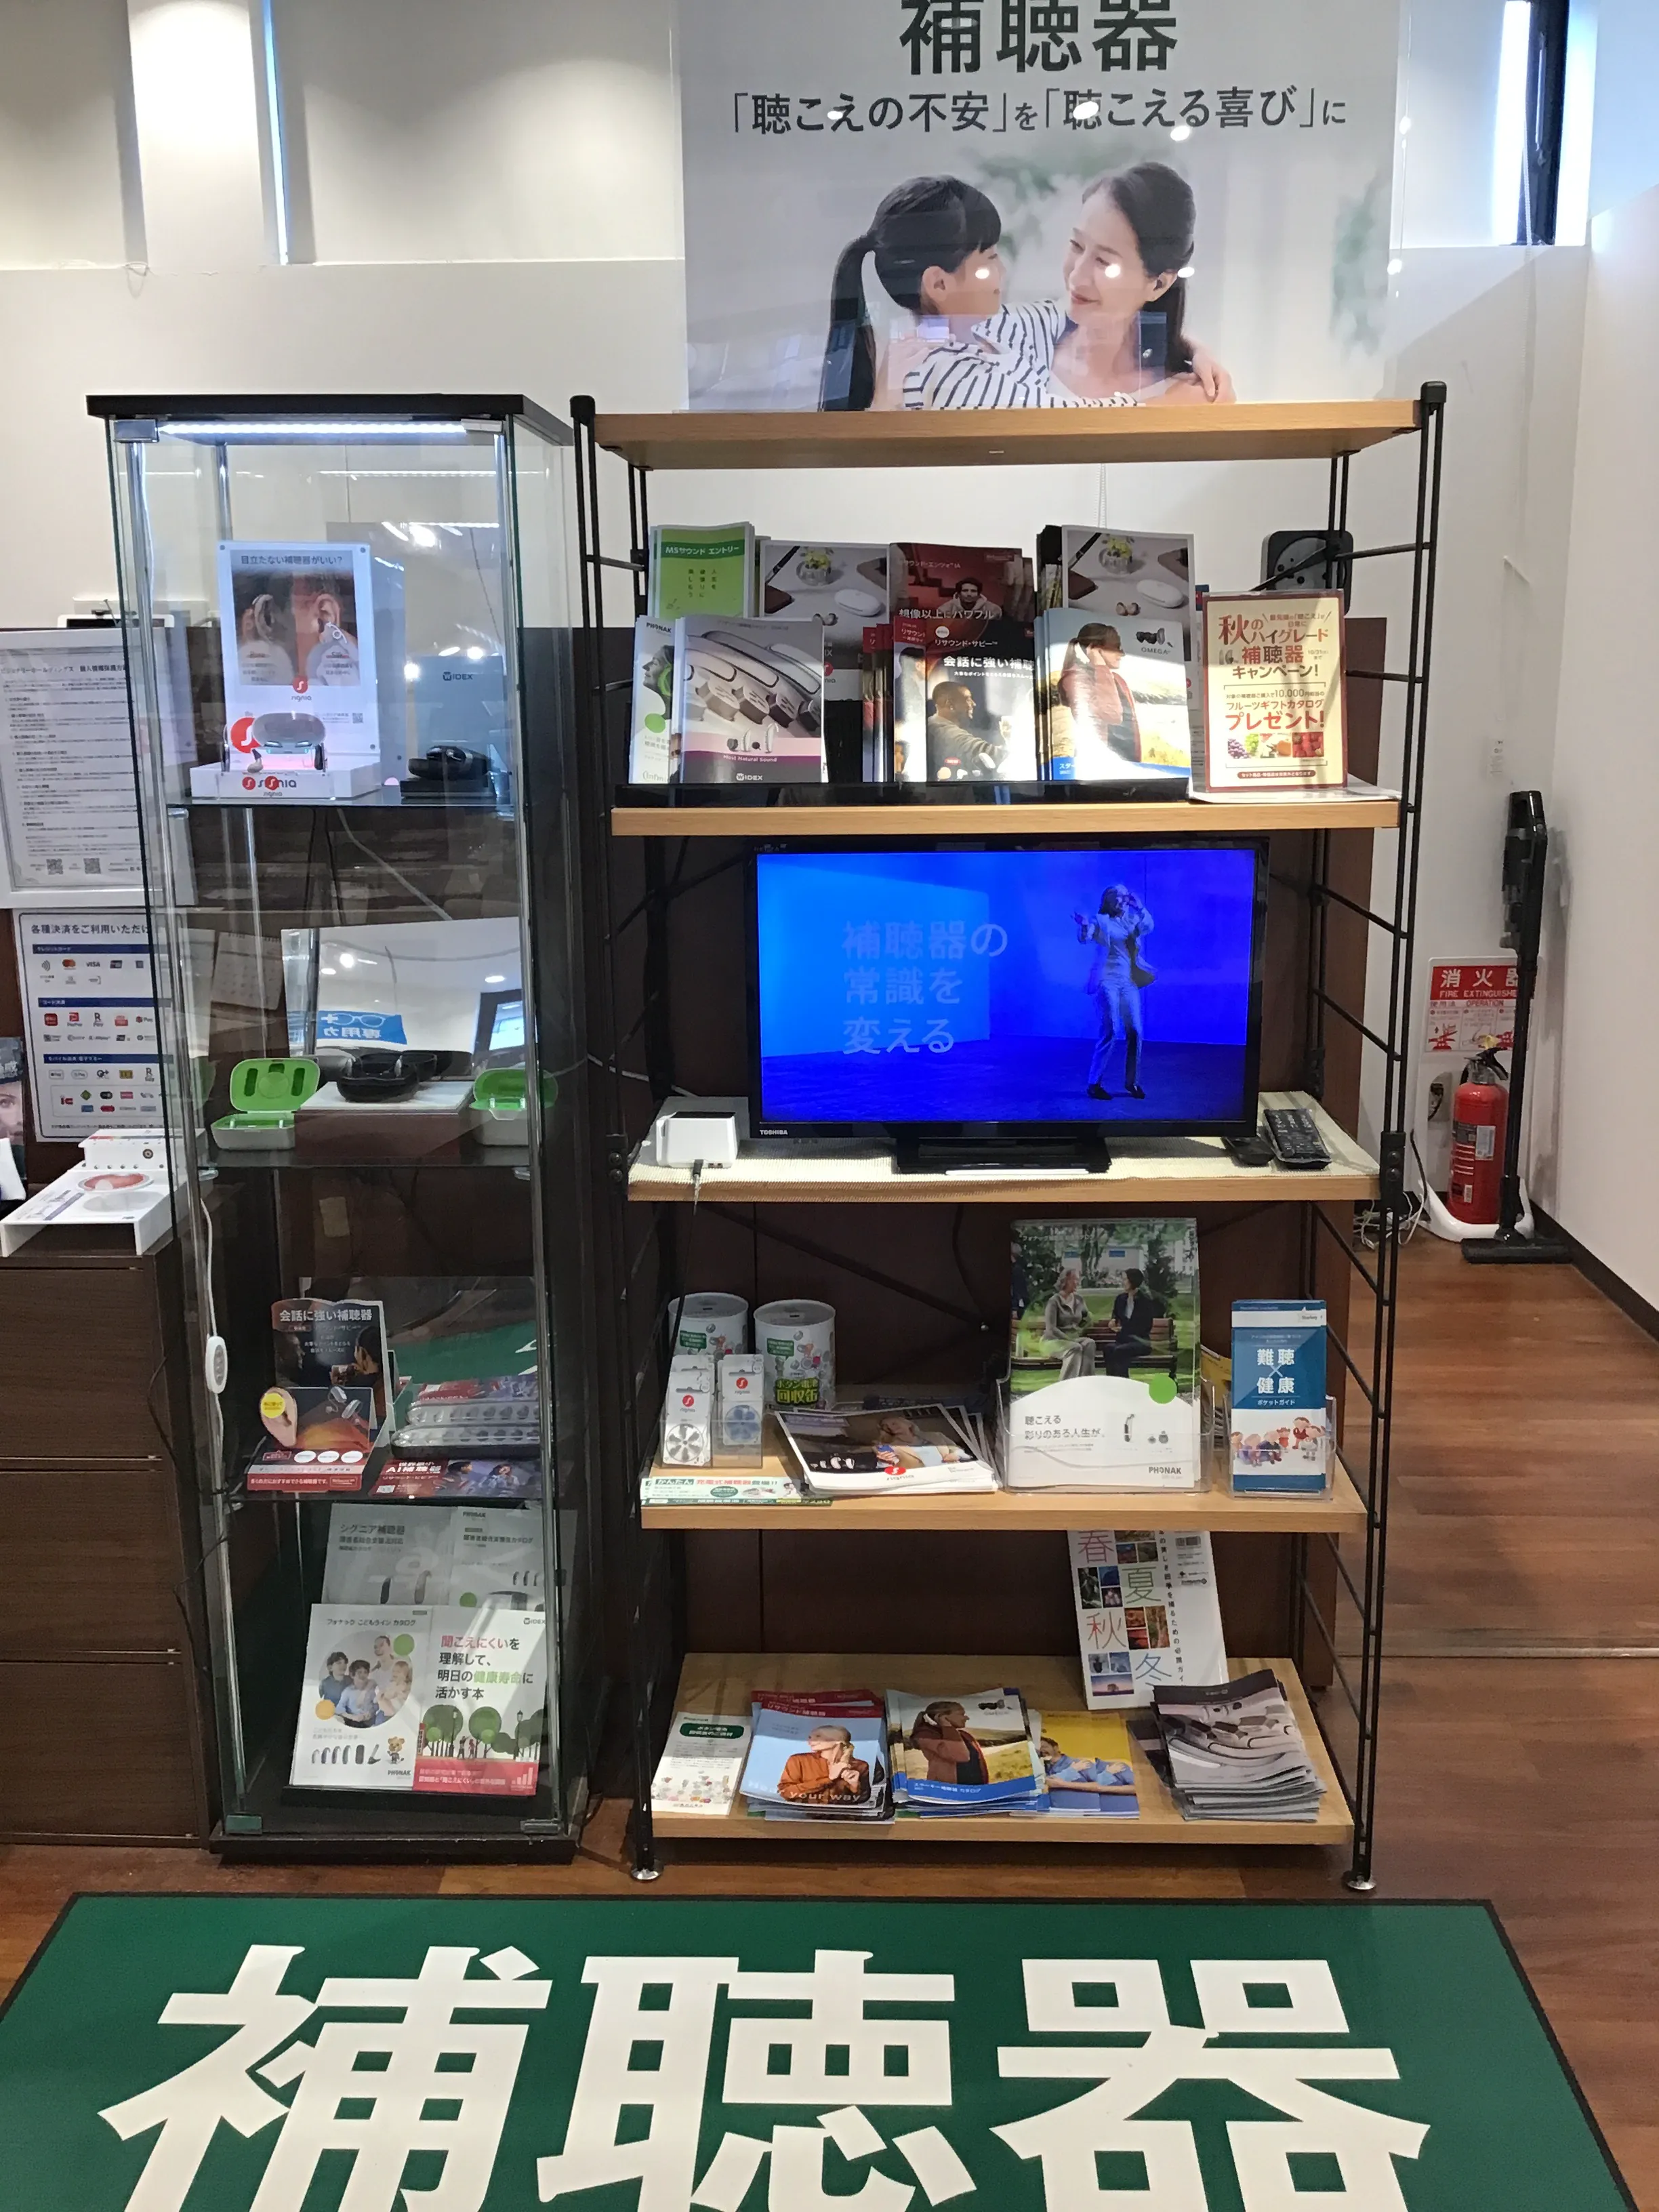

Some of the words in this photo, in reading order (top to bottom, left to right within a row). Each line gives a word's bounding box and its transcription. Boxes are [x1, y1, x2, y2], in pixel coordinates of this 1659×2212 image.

[900, 0, 1179, 75] 補聴器
[646, 622, 672, 634] PHONAK
[1242, 645, 1304, 665] 補聴器
[443, 671, 473, 681] WIDEX
[1225, 710, 1324, 731] プレゼント!
[258, 779, 297, 788] snia
[735, 772, 763, 781] WIDEX
[841, 920, 1008, 960] 補聴器の
[843, 964, 963, 1005] 常識を
[1439, 989, 1459, 998] FIRE
[1463, 989, 1517, 998] EXTINGUISHE
[1466, 1000, 1504, 1008] OPERATION
[842, 1015, 955, 1055] 変える
[279, 1309, 373, 1322] 会話に強い補聴器
[1257, 1349, 1295, 1366] 難聴
[1256, 1376, 1295, 1394] 健康
[1149, 1467, 1182, 1475] PHONAK
[1078, 1530, 1114, 1563] 春
[1122, 1566, 1162, 1604] 夏
[1086, 1611, 1126, 1650] 秋
[441, 1635, 520, 1650] 聞こえにくいを
[438, 1652, 492, 1666] 理解して、
[437, 1669, 534, 1685] 明日の健康寿命に
[1135, 1653, 1172, 1685] 冬
[434, 1685, 485, 1700] 活かす本
[790, 1790, 824, 1801] your
[830, 1793, 861, 1803] way
[97, 1944, 1432, 2212] 補聴器
